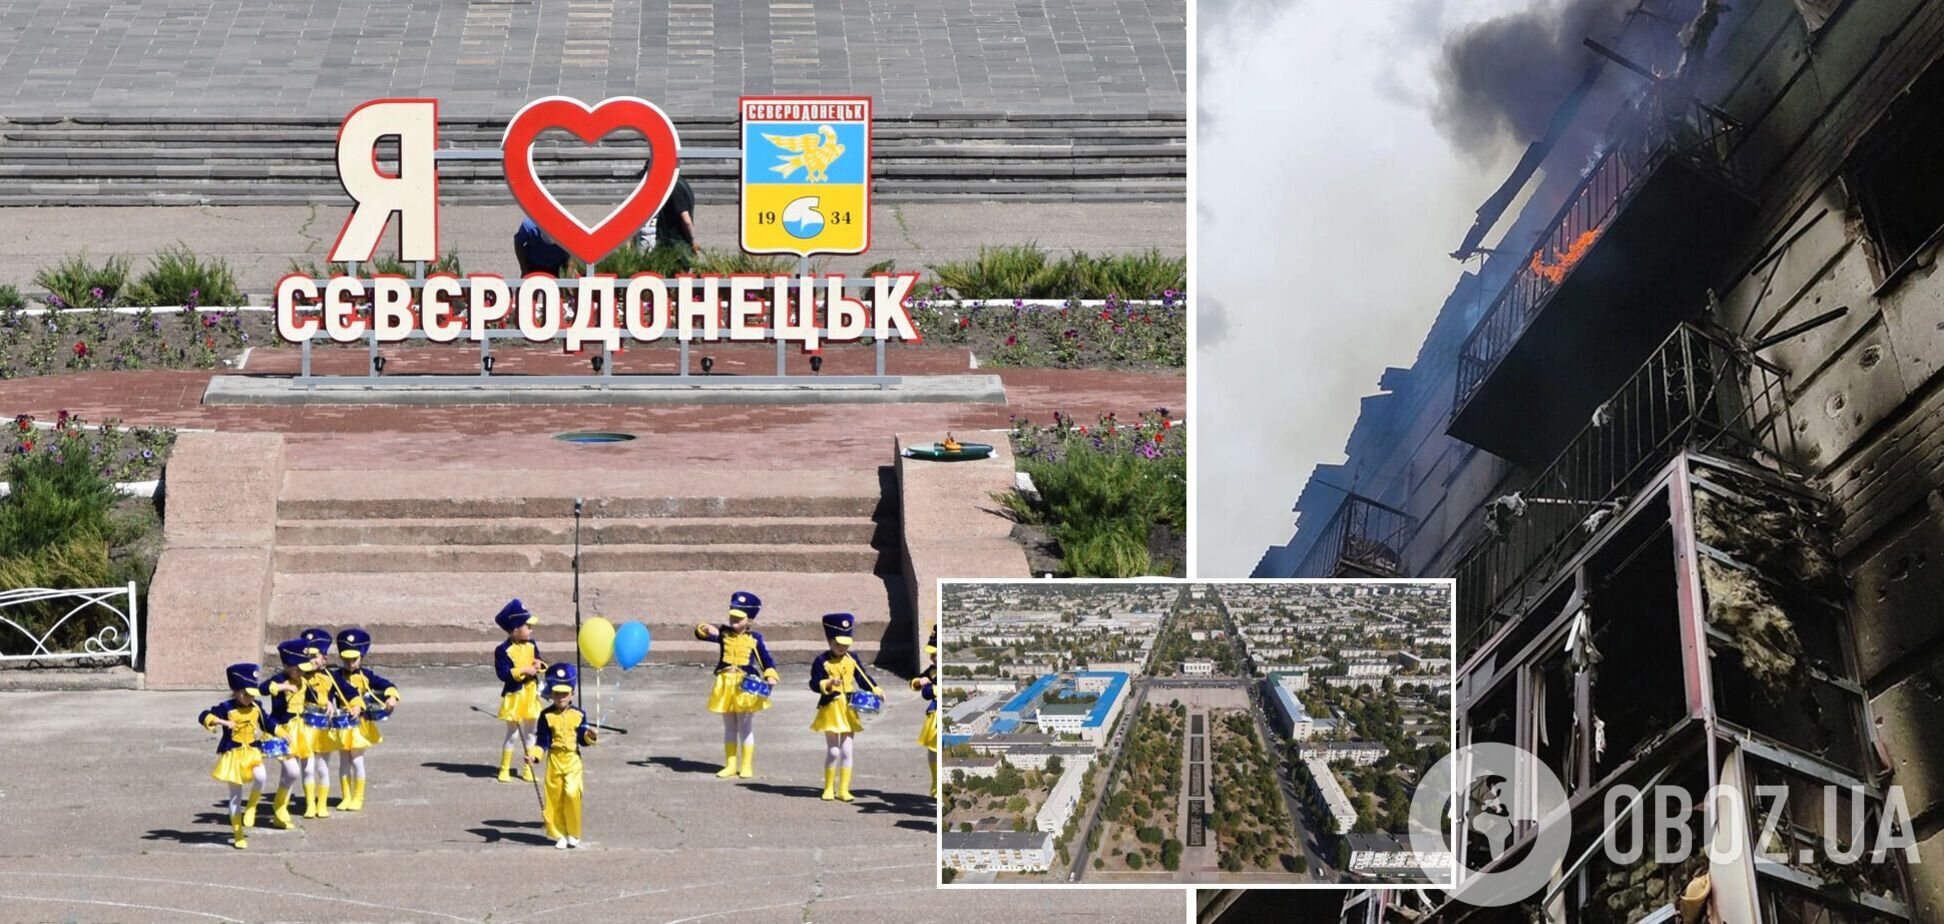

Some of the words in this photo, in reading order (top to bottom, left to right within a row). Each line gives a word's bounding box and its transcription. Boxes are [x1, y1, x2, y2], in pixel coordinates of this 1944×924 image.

[749, 105, 862, 120] СЄВЄРОДОНЕЦЬК
[329, 99, 438, 262] Я
[758, 211, 776, 224] 19
[830, 211, 851, 224] 34
[275, 273, 922, 353] СЄВЄРОДОНЕЦЬК
